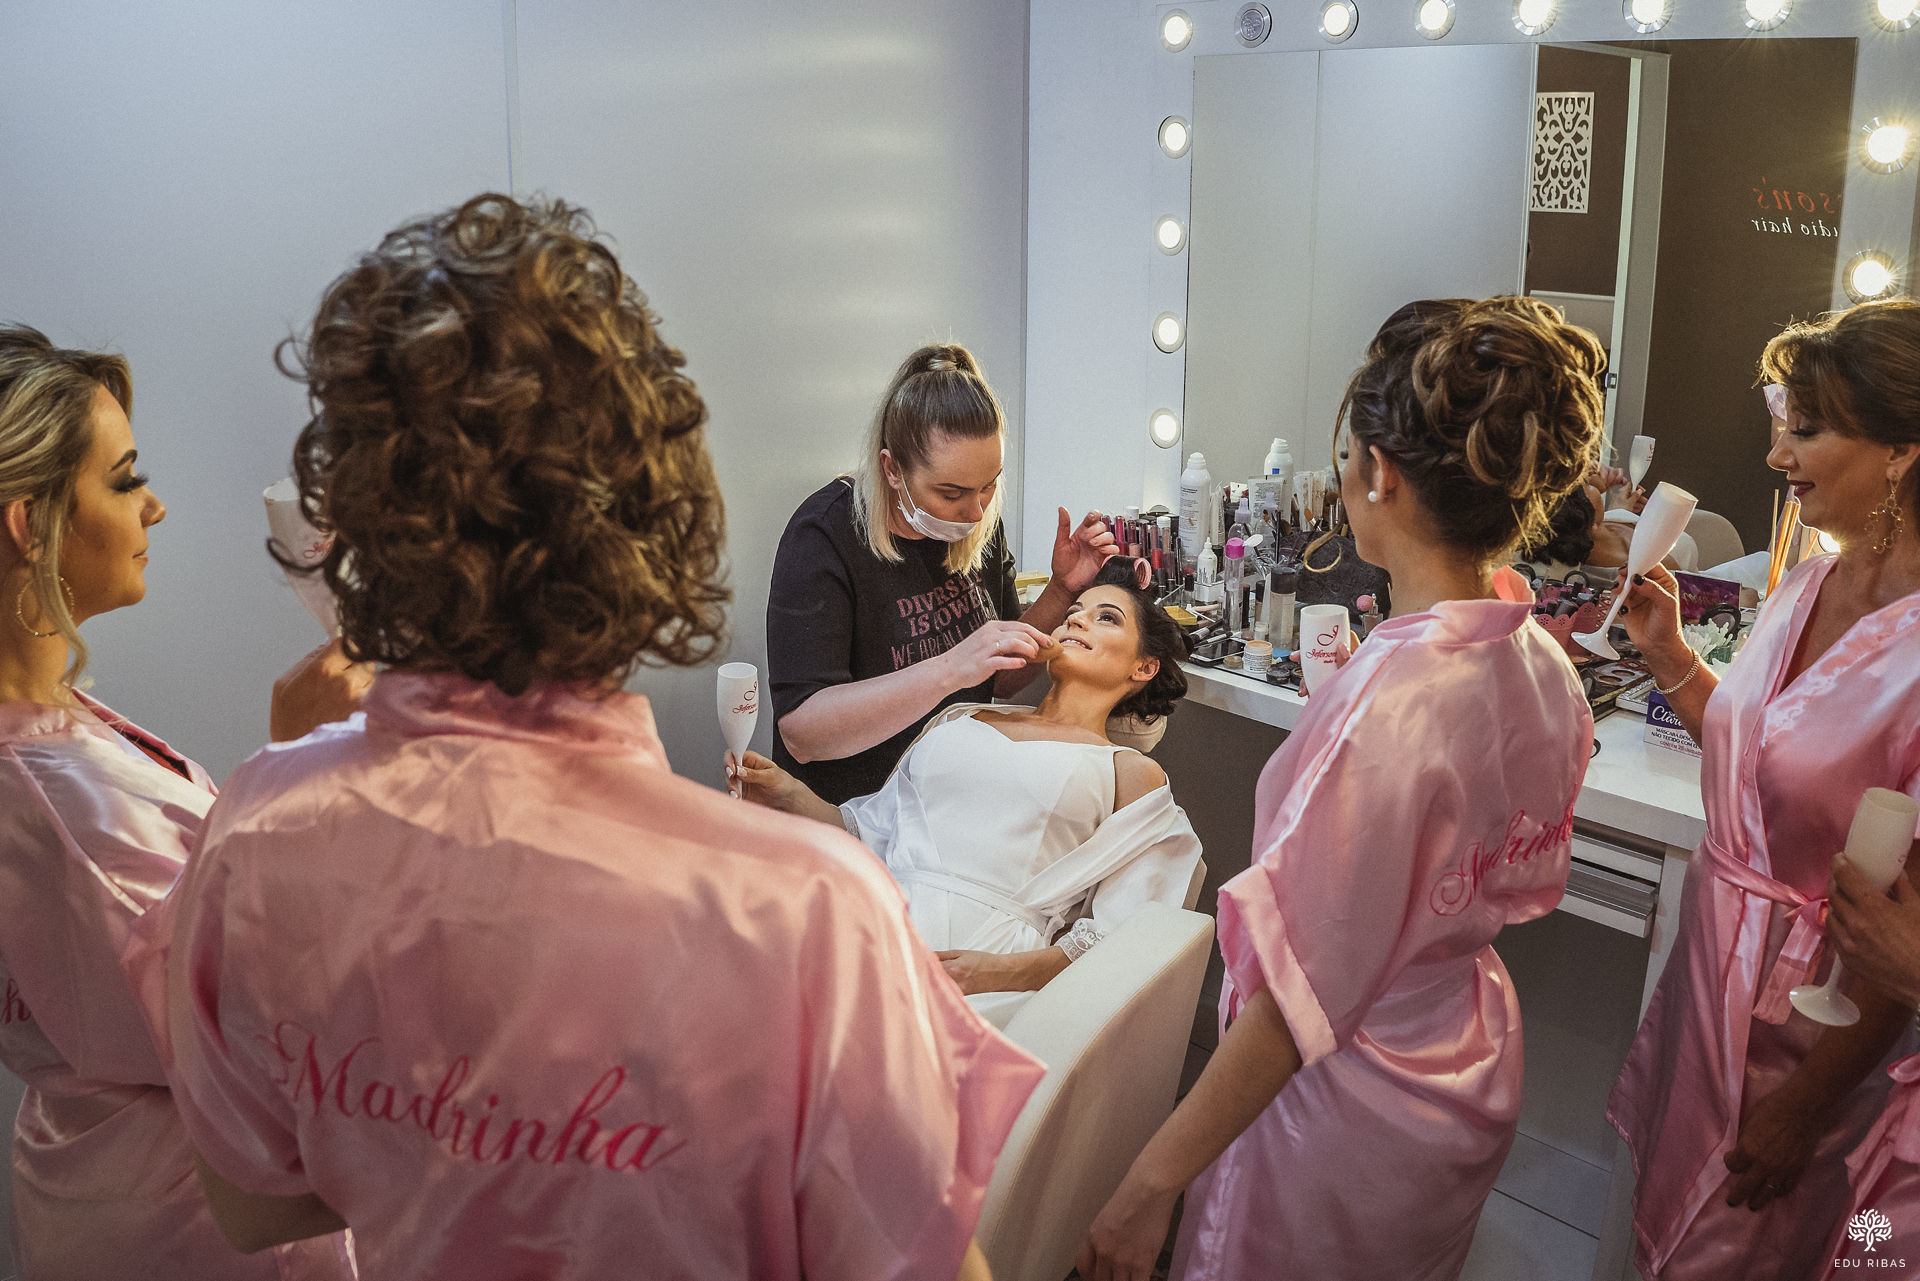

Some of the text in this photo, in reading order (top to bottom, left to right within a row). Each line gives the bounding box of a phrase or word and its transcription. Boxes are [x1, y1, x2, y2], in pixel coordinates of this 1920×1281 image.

[908, 614, 930, 637] IS
[1663, 734, 1681, 744] TECIDO
[255, 1020, 688, 1173] Madrinha
